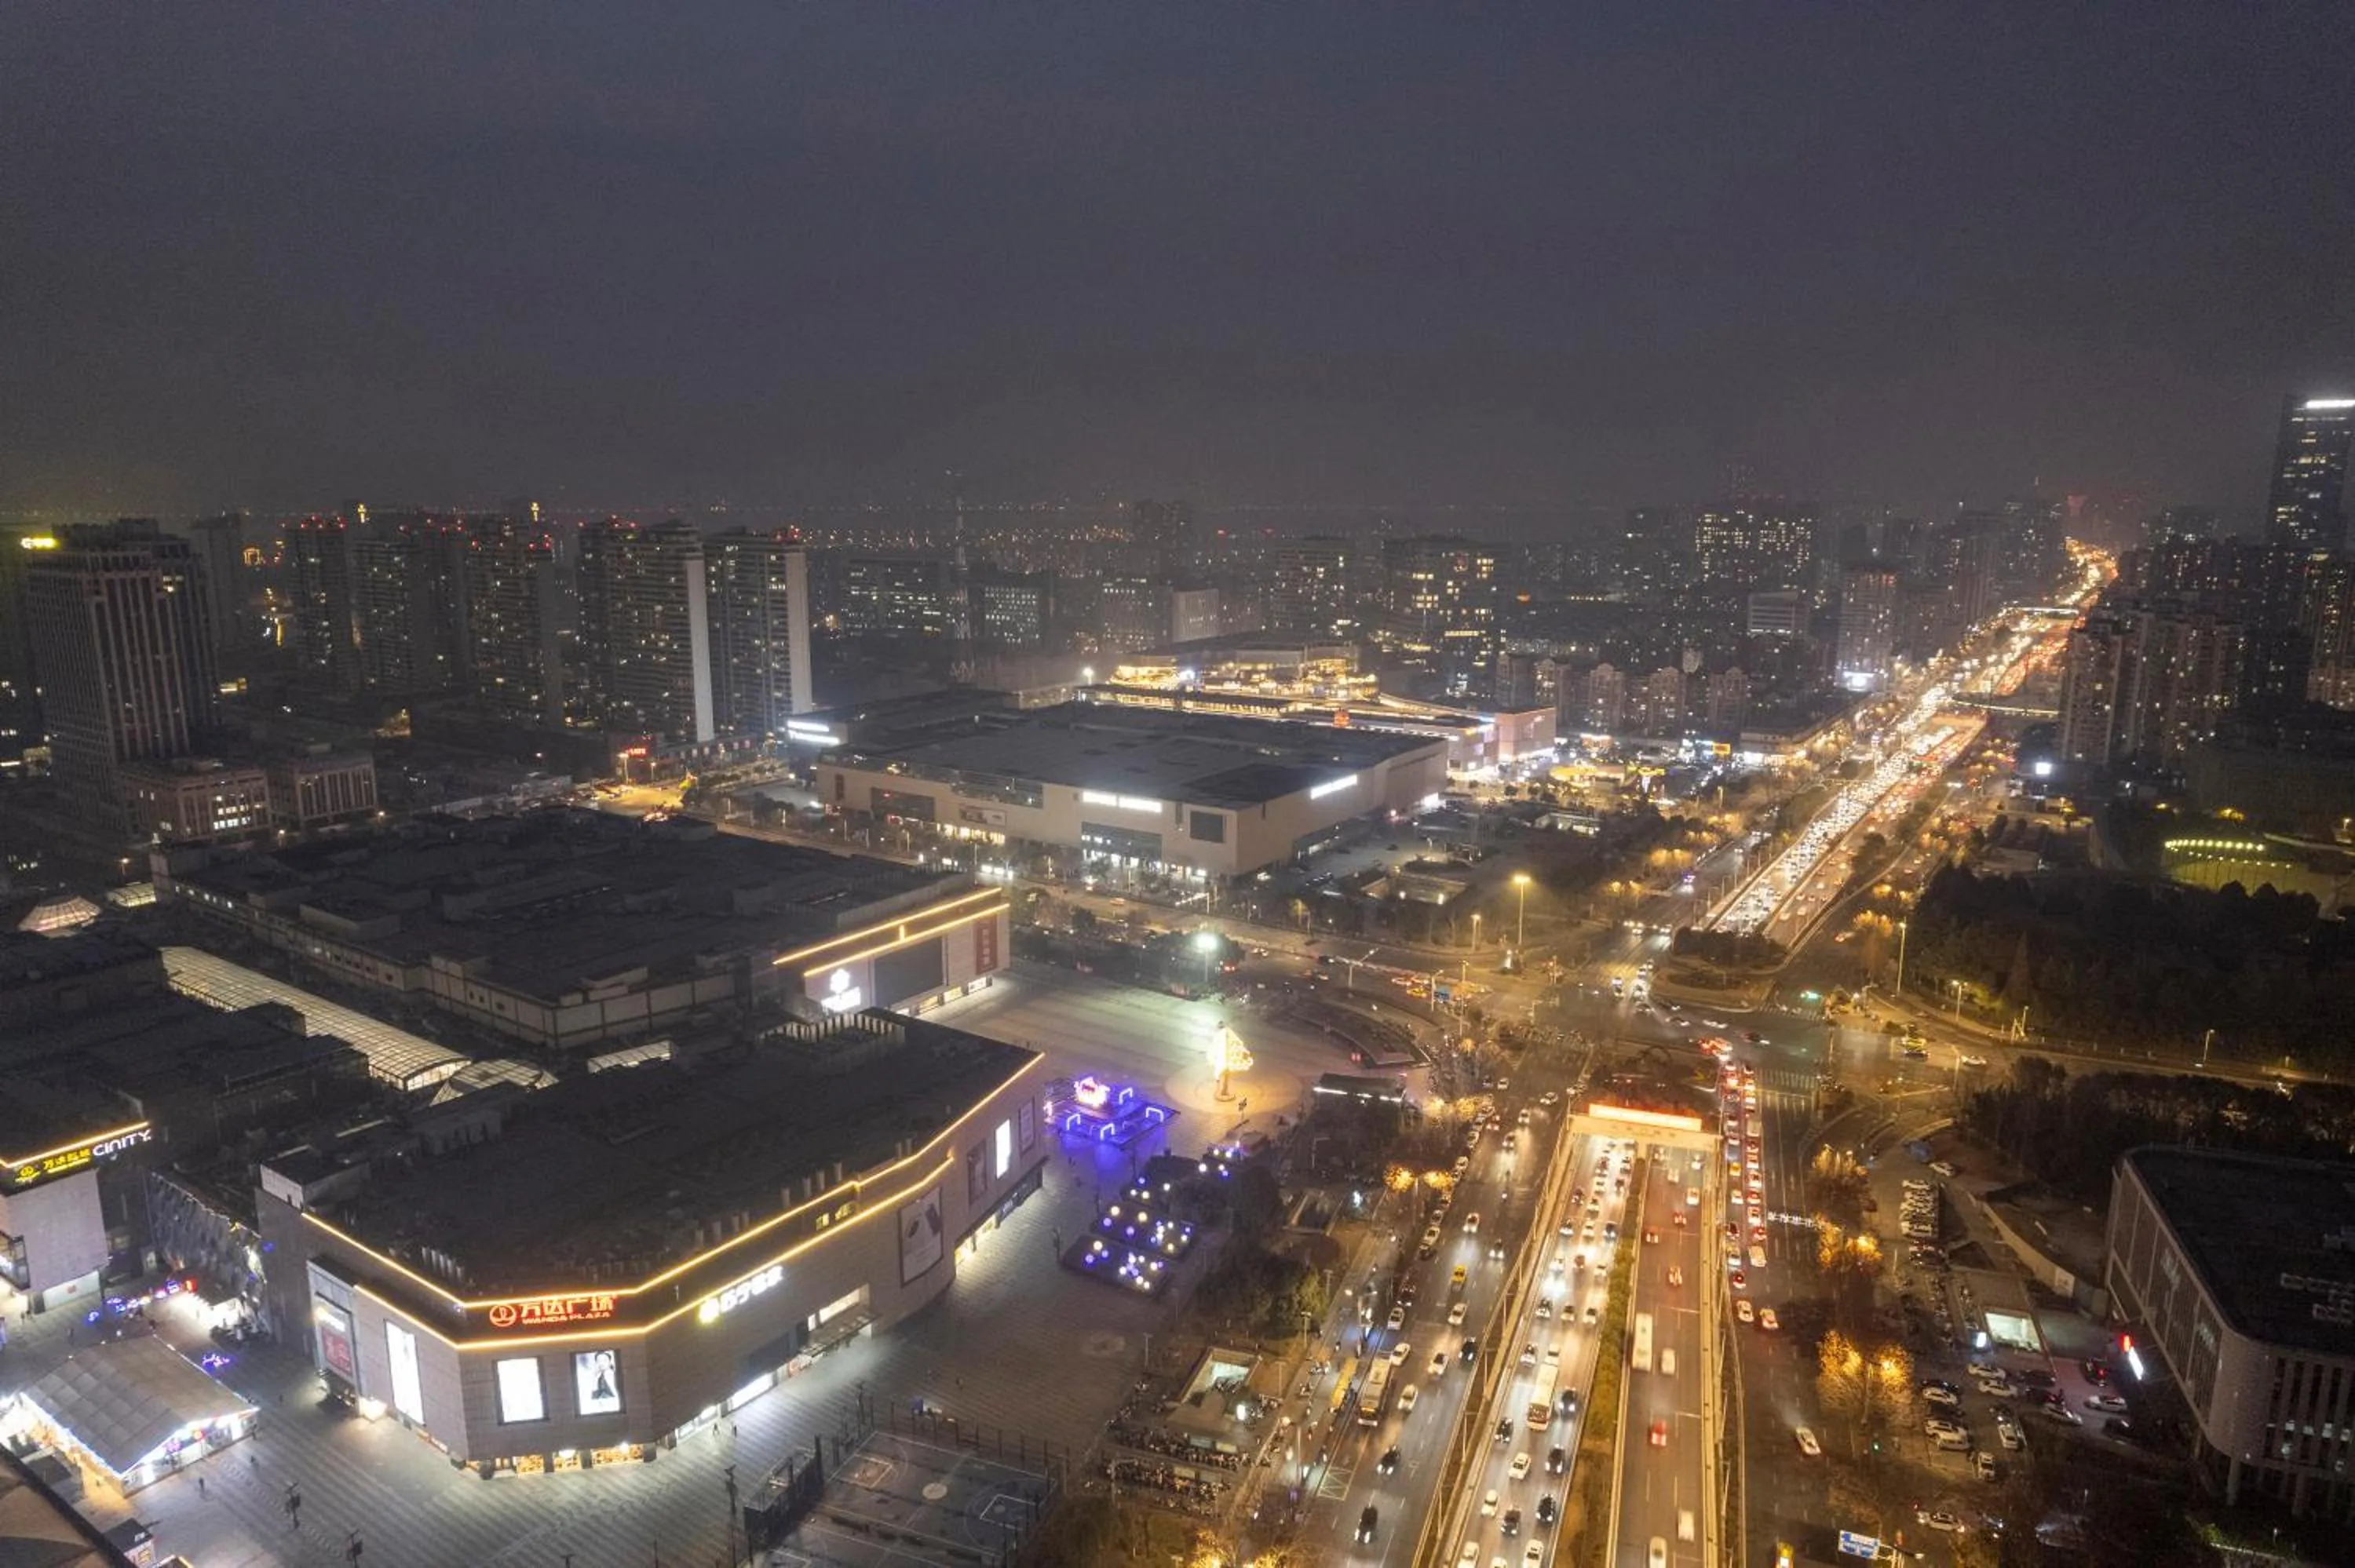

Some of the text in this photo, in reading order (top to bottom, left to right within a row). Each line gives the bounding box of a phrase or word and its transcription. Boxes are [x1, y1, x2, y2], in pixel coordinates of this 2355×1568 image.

[93, 1129, 151, 1156] CINITY
[520, 1296, 615, 1318] 万达广场
